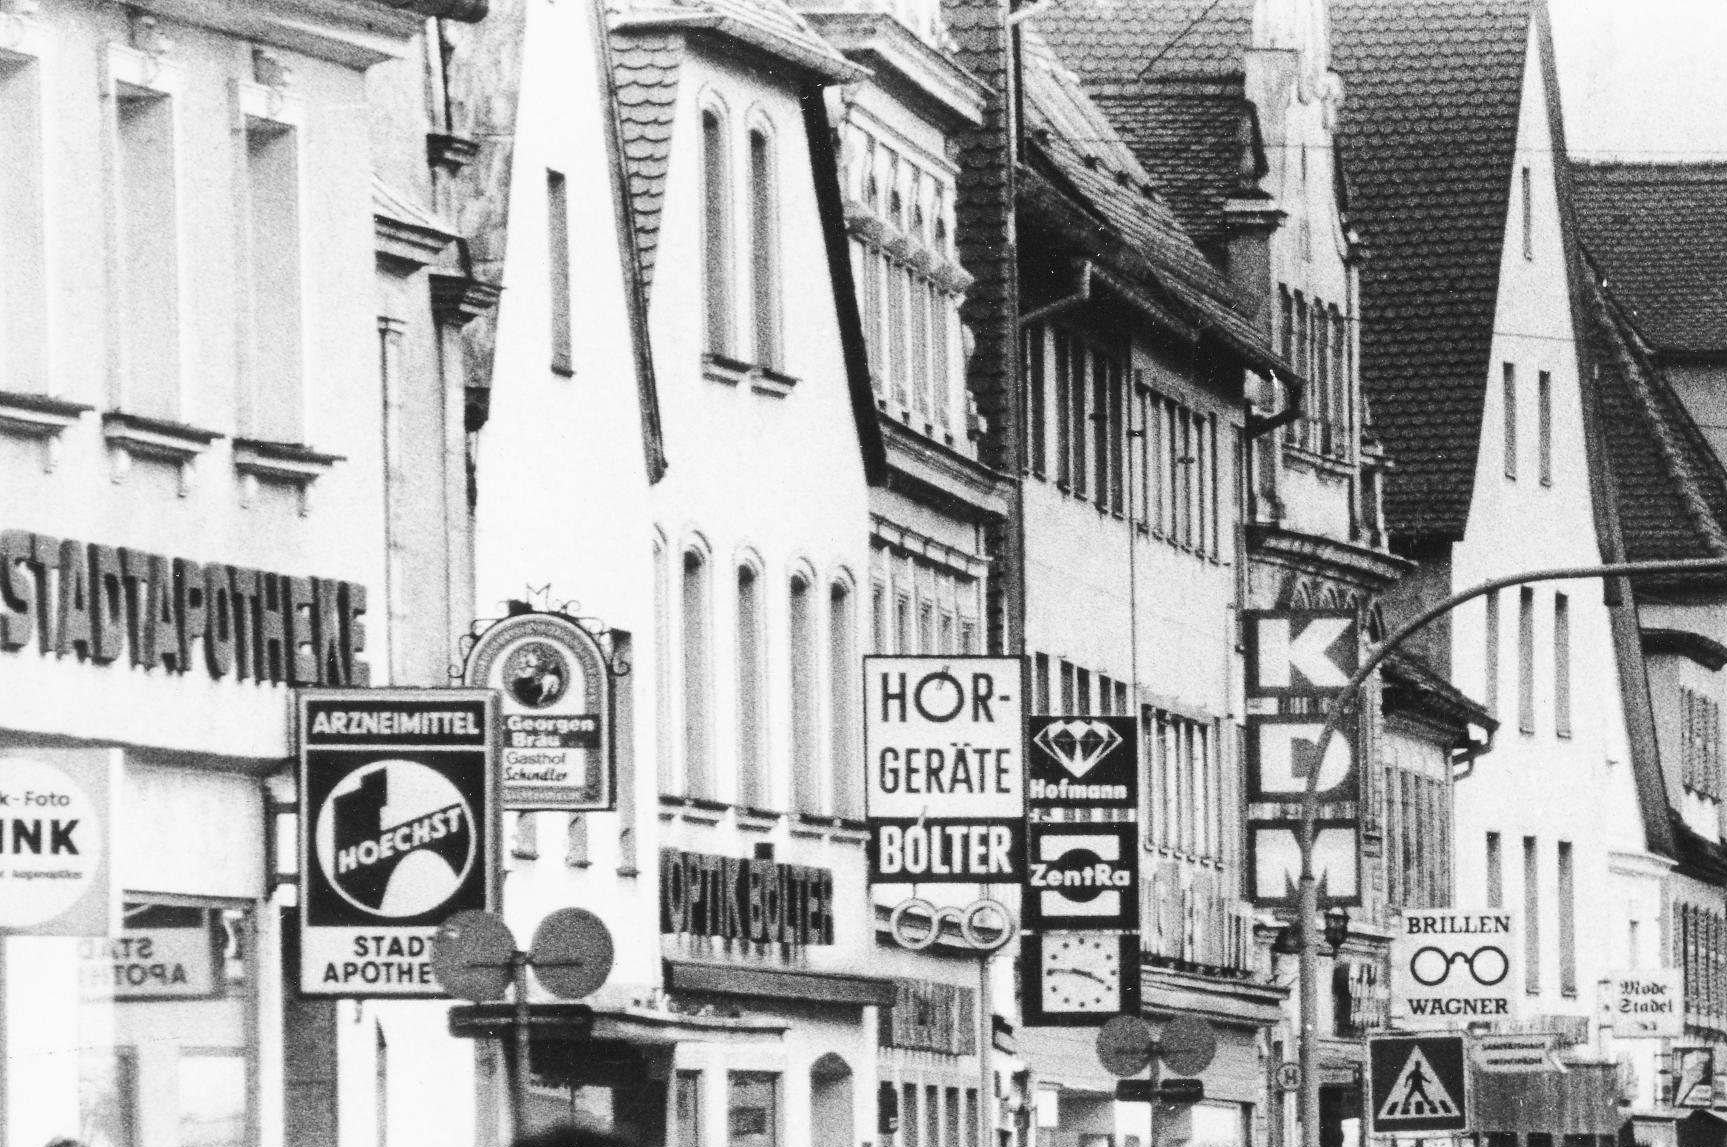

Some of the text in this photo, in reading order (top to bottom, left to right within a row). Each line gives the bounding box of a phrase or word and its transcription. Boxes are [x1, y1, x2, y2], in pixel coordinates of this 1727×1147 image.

[312, 712, 480, 734] ARZNEIMITTEL
[507, 716, 595, 733] Georgen
[506, 752, 566, 765] Gasthof
[879, 742, 1011, 794] GERÄTE
[1030, 778, 1127, 799] Hofmann
[339, 806, 462, 874] HOECHST
[1030, 863, 1131, 886] ZentRa
[1407, 916, 1510, 934] BRILLEN
[354, 936, 434, 958] STAD
[1408, 999, 1509, 1015] WAGNER
